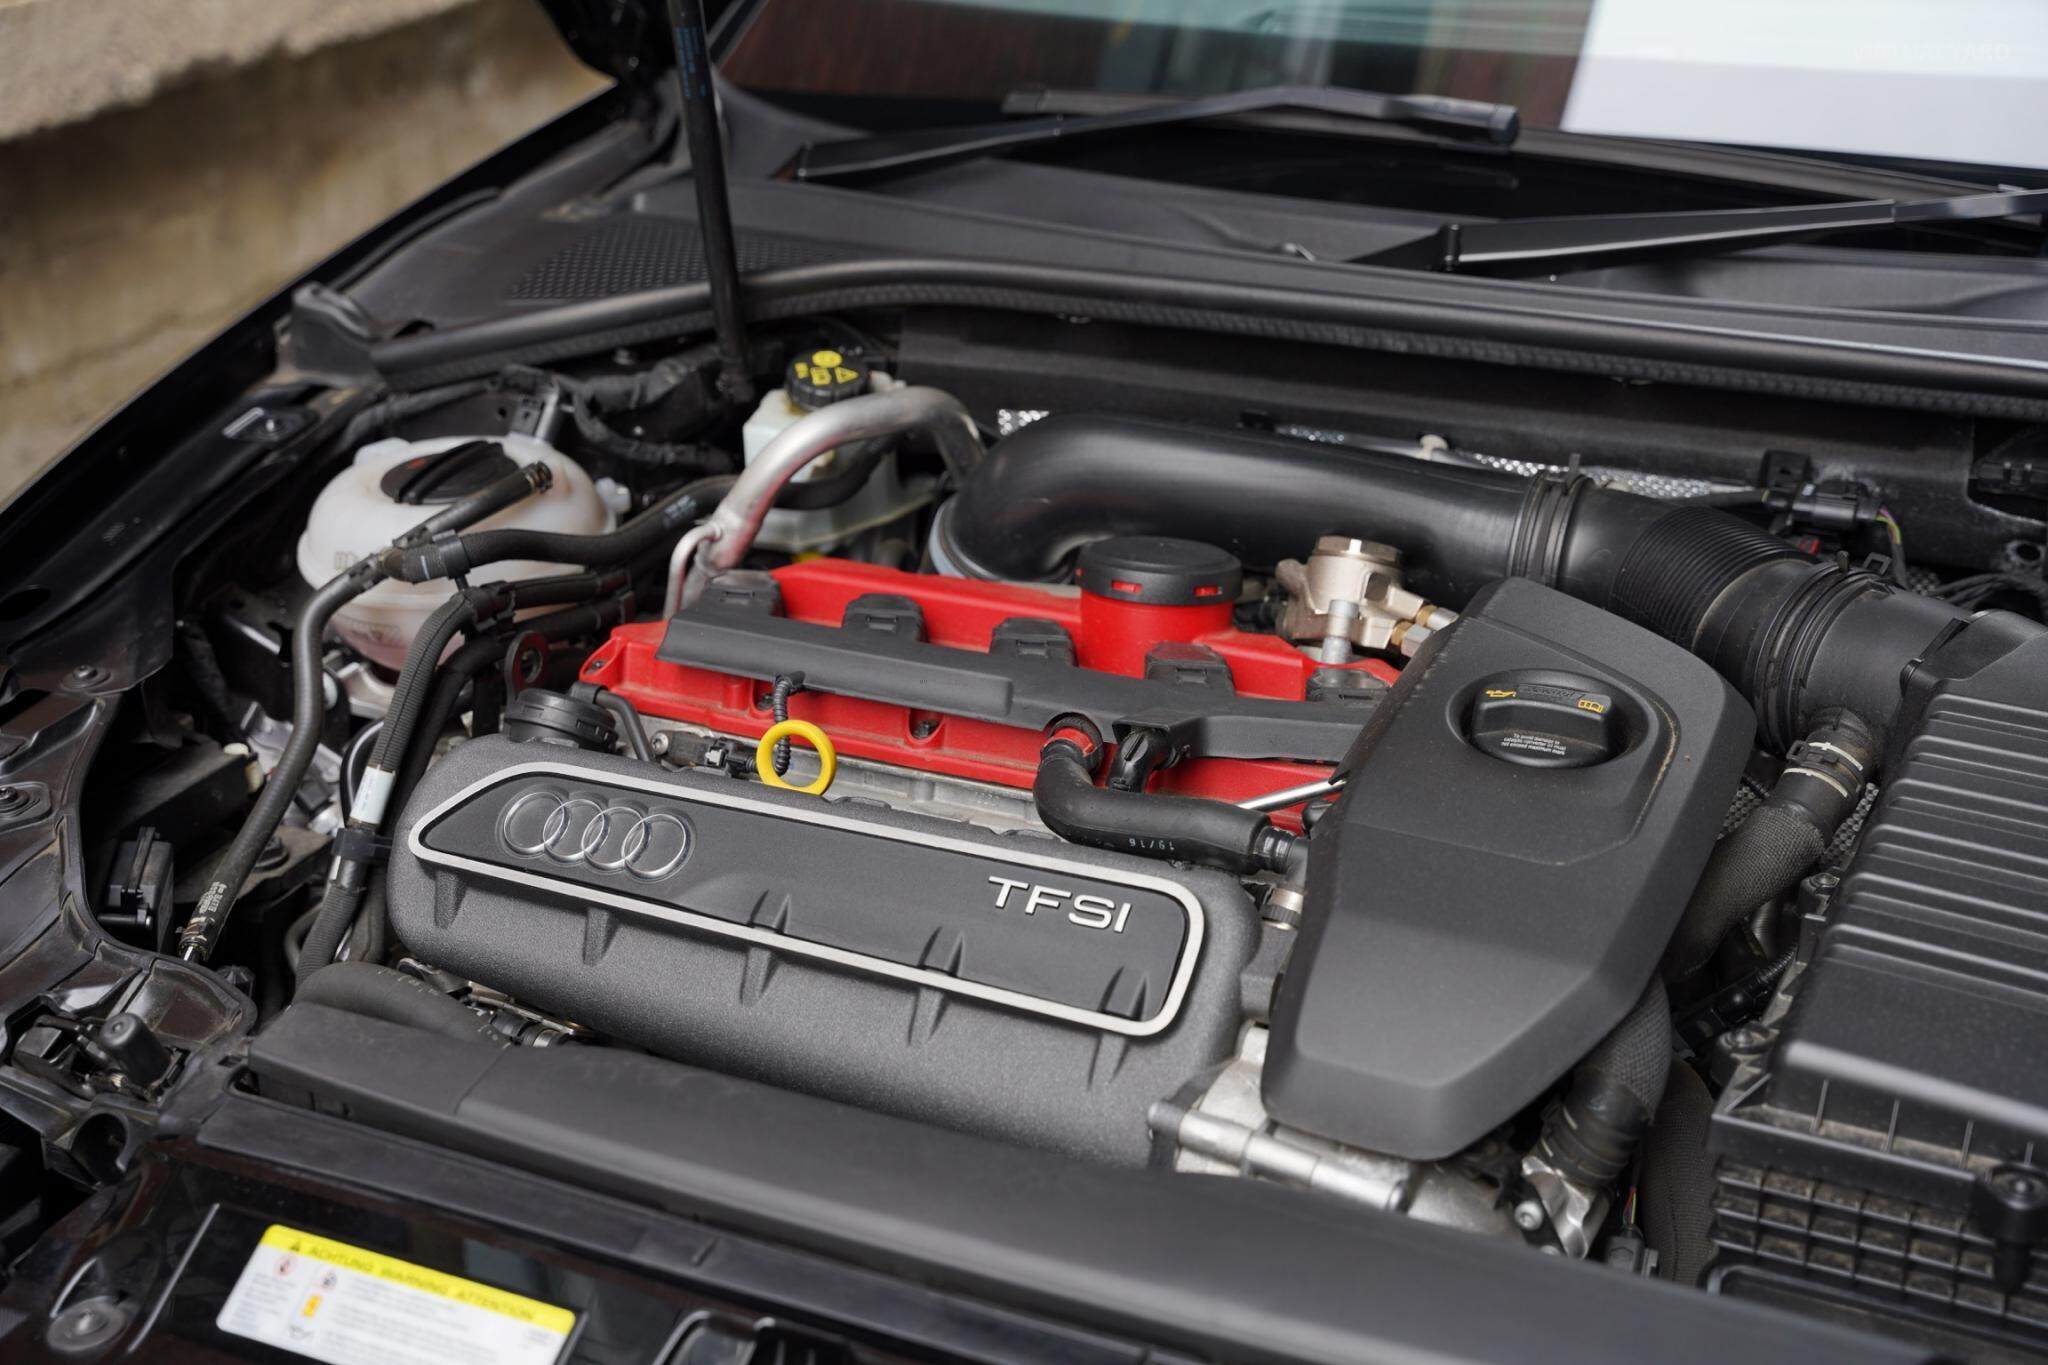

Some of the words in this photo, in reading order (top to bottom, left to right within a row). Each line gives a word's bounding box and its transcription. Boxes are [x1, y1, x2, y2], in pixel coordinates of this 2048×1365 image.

[988, 876, 1132, 933] TFSI
[309, 1247, 374, 1273] ACHTUNG
[381, 1267, 448, 1295] WARNING
[458, 1290, 535, 1321] ATTENTION
